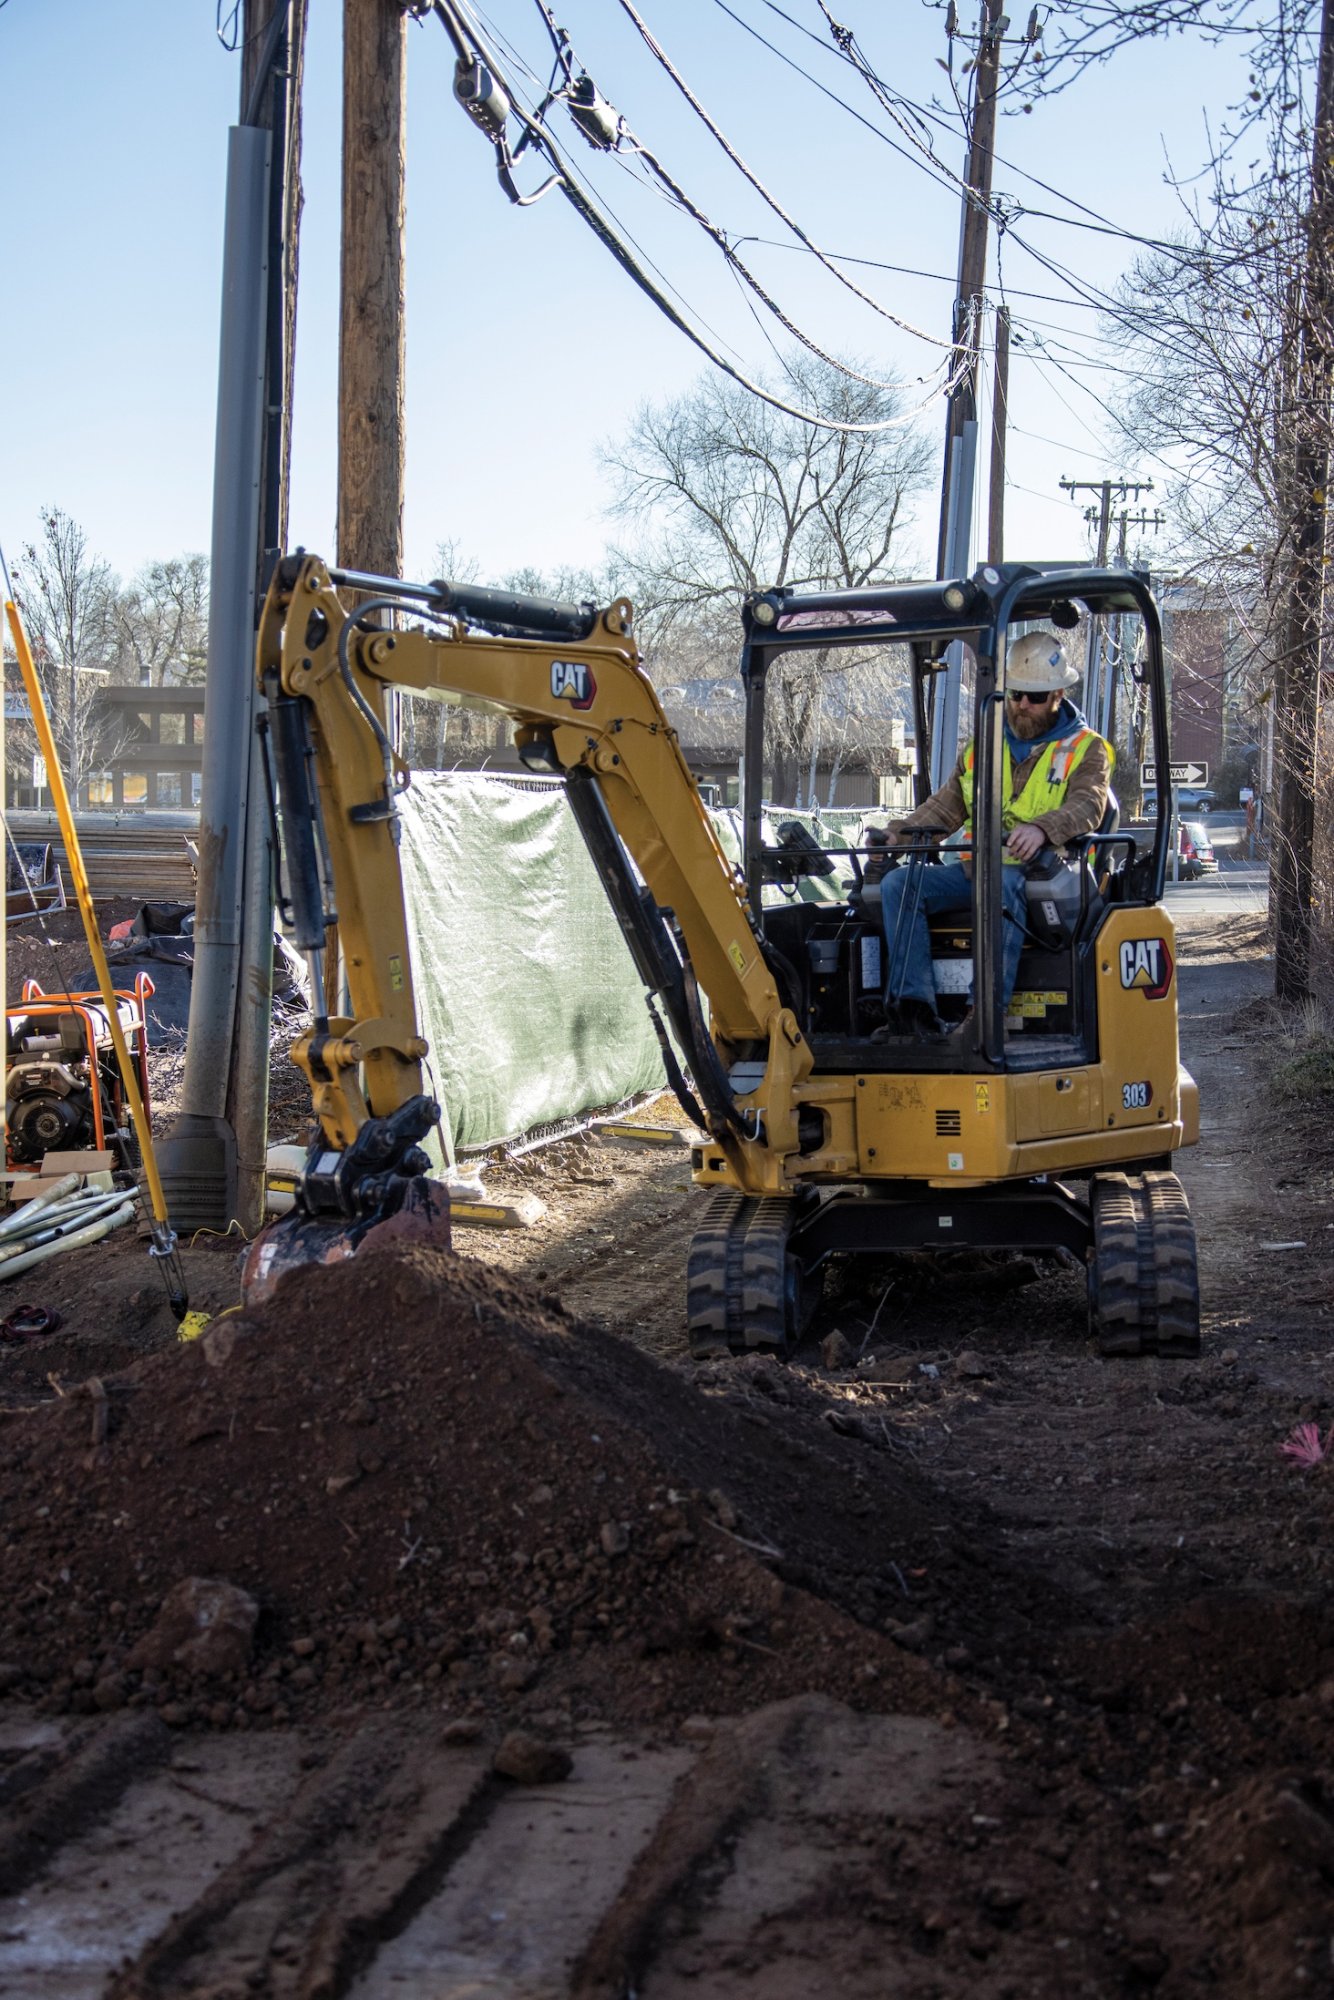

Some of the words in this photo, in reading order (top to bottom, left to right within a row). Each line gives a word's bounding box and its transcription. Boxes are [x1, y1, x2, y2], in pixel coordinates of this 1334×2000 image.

[551, 661, 587, 699] CAT
[1120, 940, 1160, 987] CAT
[1122, 1083, 1146, 1108] 303
